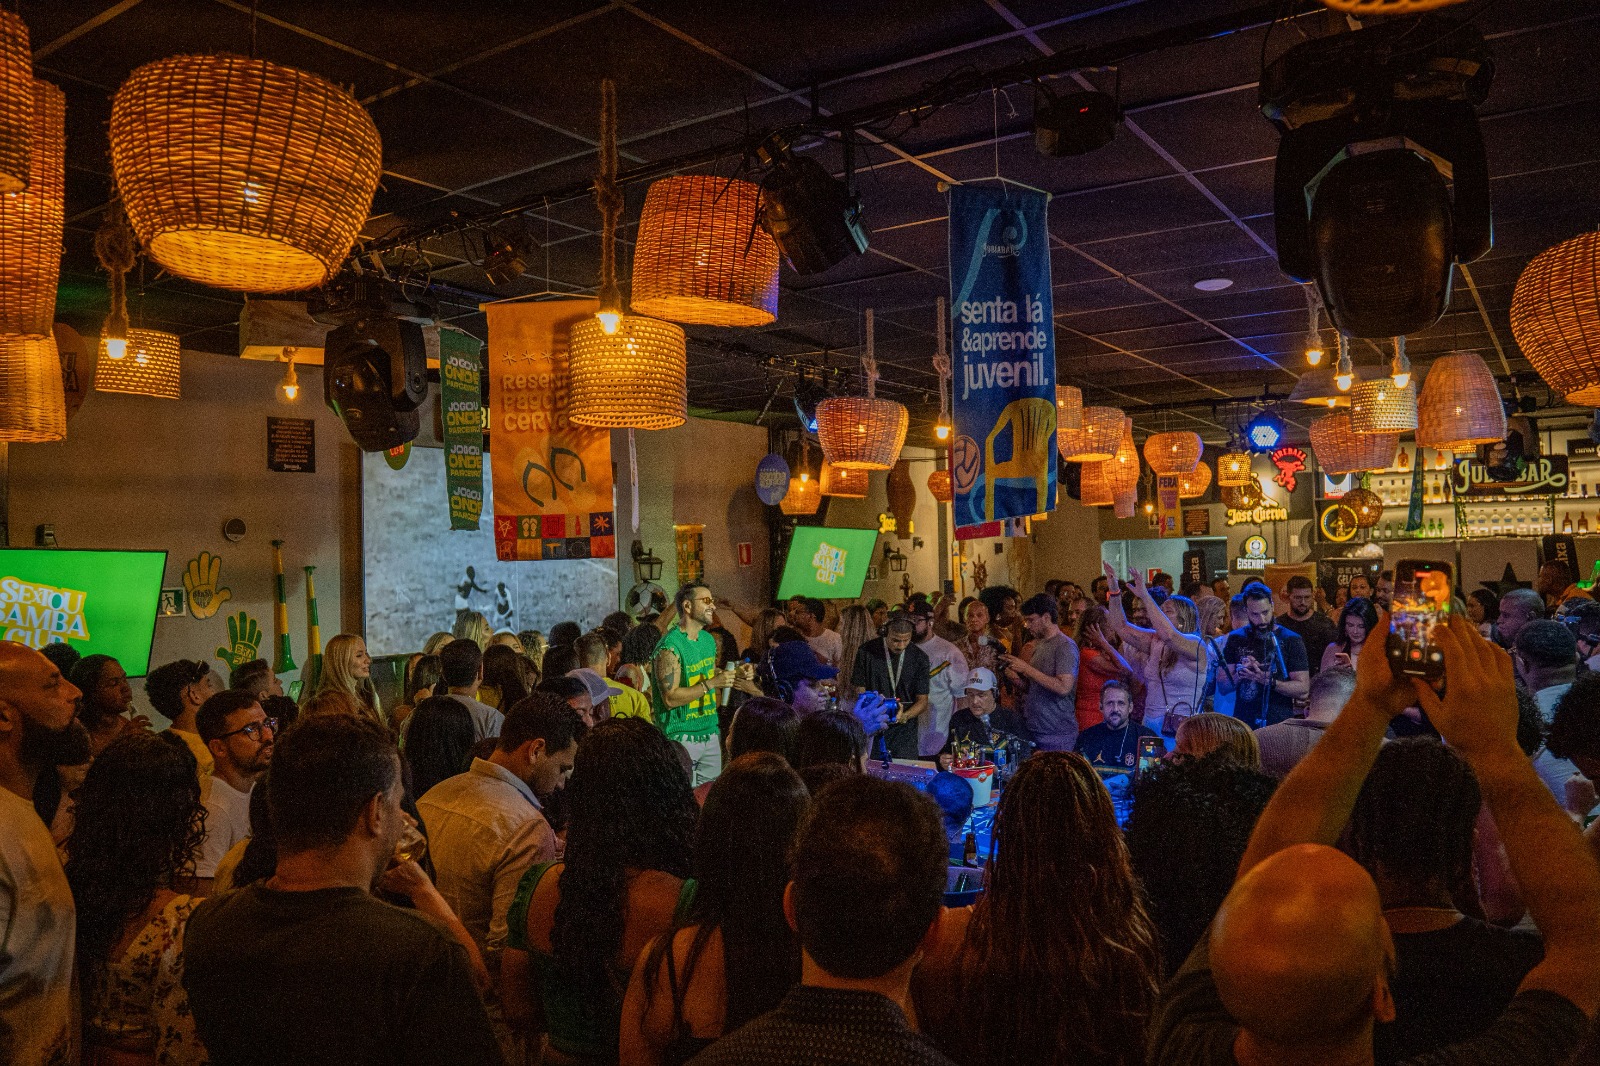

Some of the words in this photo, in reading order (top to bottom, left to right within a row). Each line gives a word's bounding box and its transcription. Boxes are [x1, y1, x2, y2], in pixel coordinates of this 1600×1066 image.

[961, 296, 1017, 324] senta
[1026, 293, 1043, 323] lá
[962, 326, 1047, 357] &aprende
[445, 364, 479, 385] ONDE
[962, 353, 1048, 400] juvenil.
[447, 411, 480, 425] ONDE
[449, 454, 482, 468] ONDE
[1272, 447, 1307, 462] FIREBALL
[1252, 506, 1287, 523] Cuervo
[0, 579, 83, 614] SEXTOU
